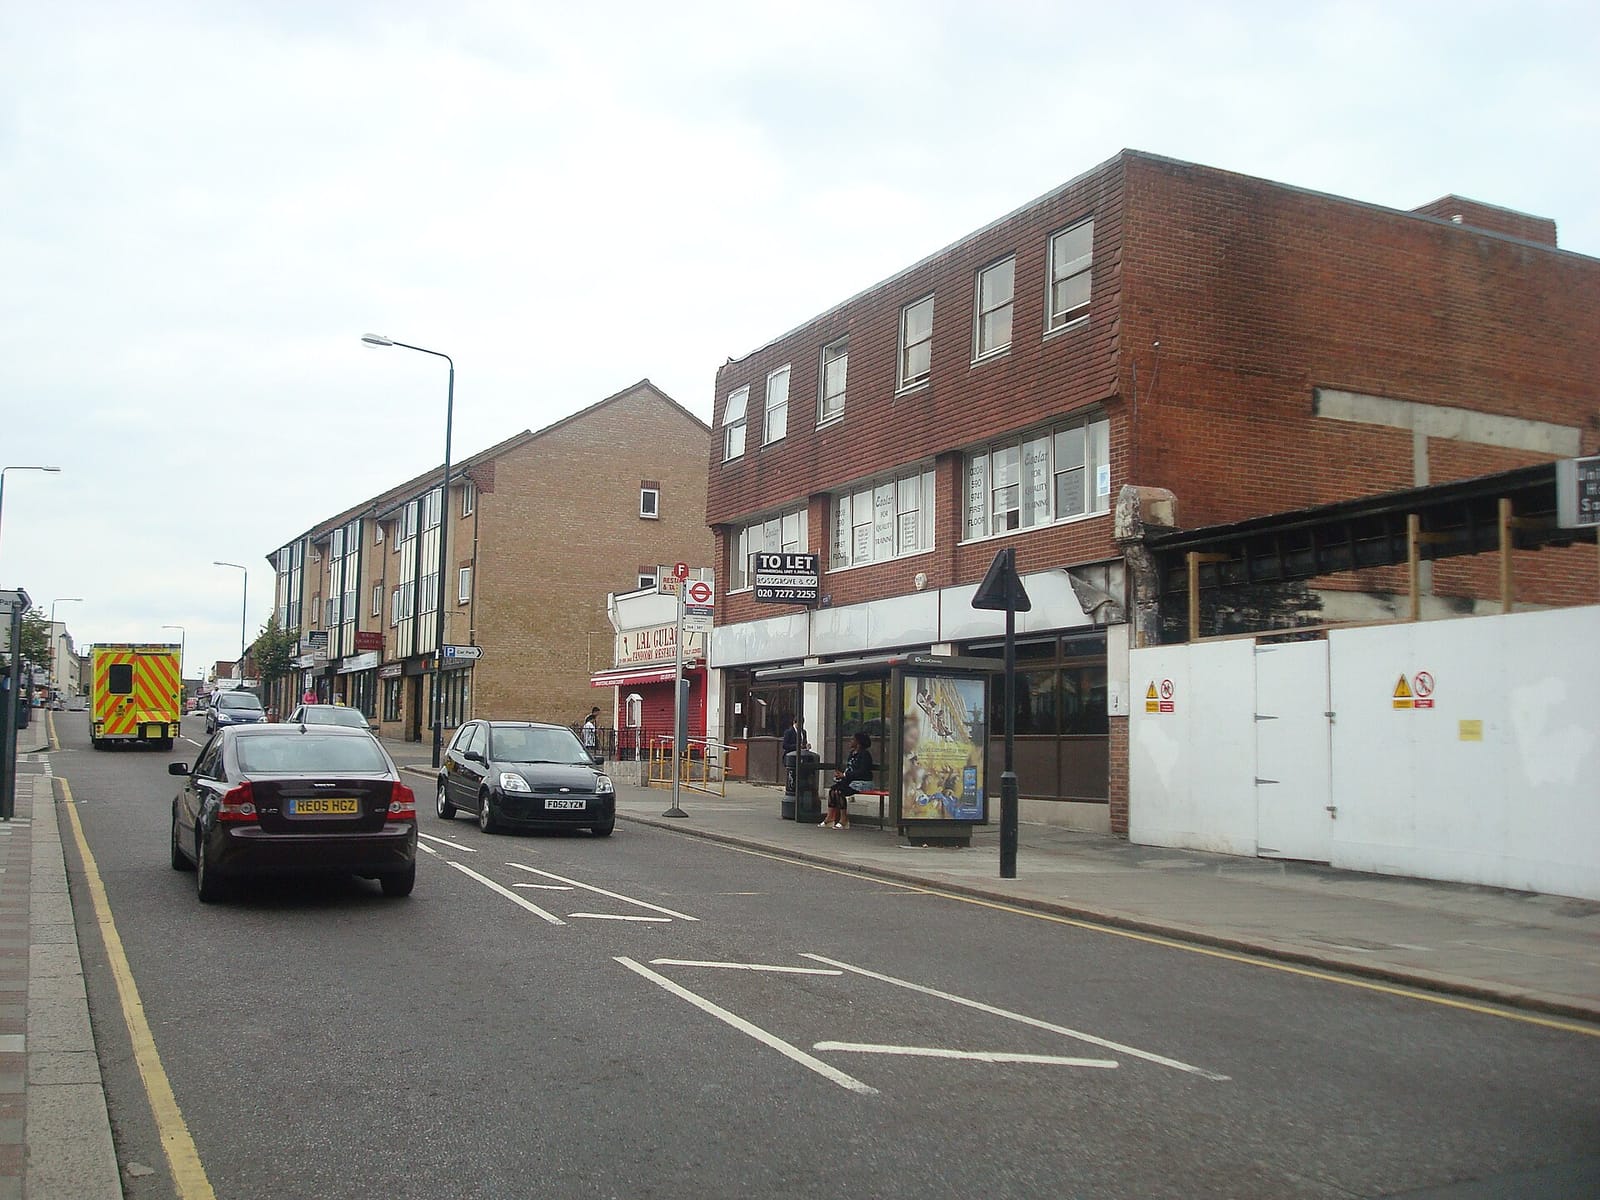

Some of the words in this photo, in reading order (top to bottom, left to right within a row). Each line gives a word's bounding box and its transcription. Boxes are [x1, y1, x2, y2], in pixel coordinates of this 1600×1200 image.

[760, 555, 781, 569] TO
[786, 556, 813, 569] LET
[678, 564, 685, 576] F
[806, 578, 817, 586] CO
[757, 589, 773, 598] 020
[774, 589, 795, 599] 7272
[796, 590, 817, 599] 2255
[636, 631, 651, 651] LAL
[447, 647, 455, 657] P
[297, 801, 329, 812] RE05
[331, 801, 356, 812] HGZ
